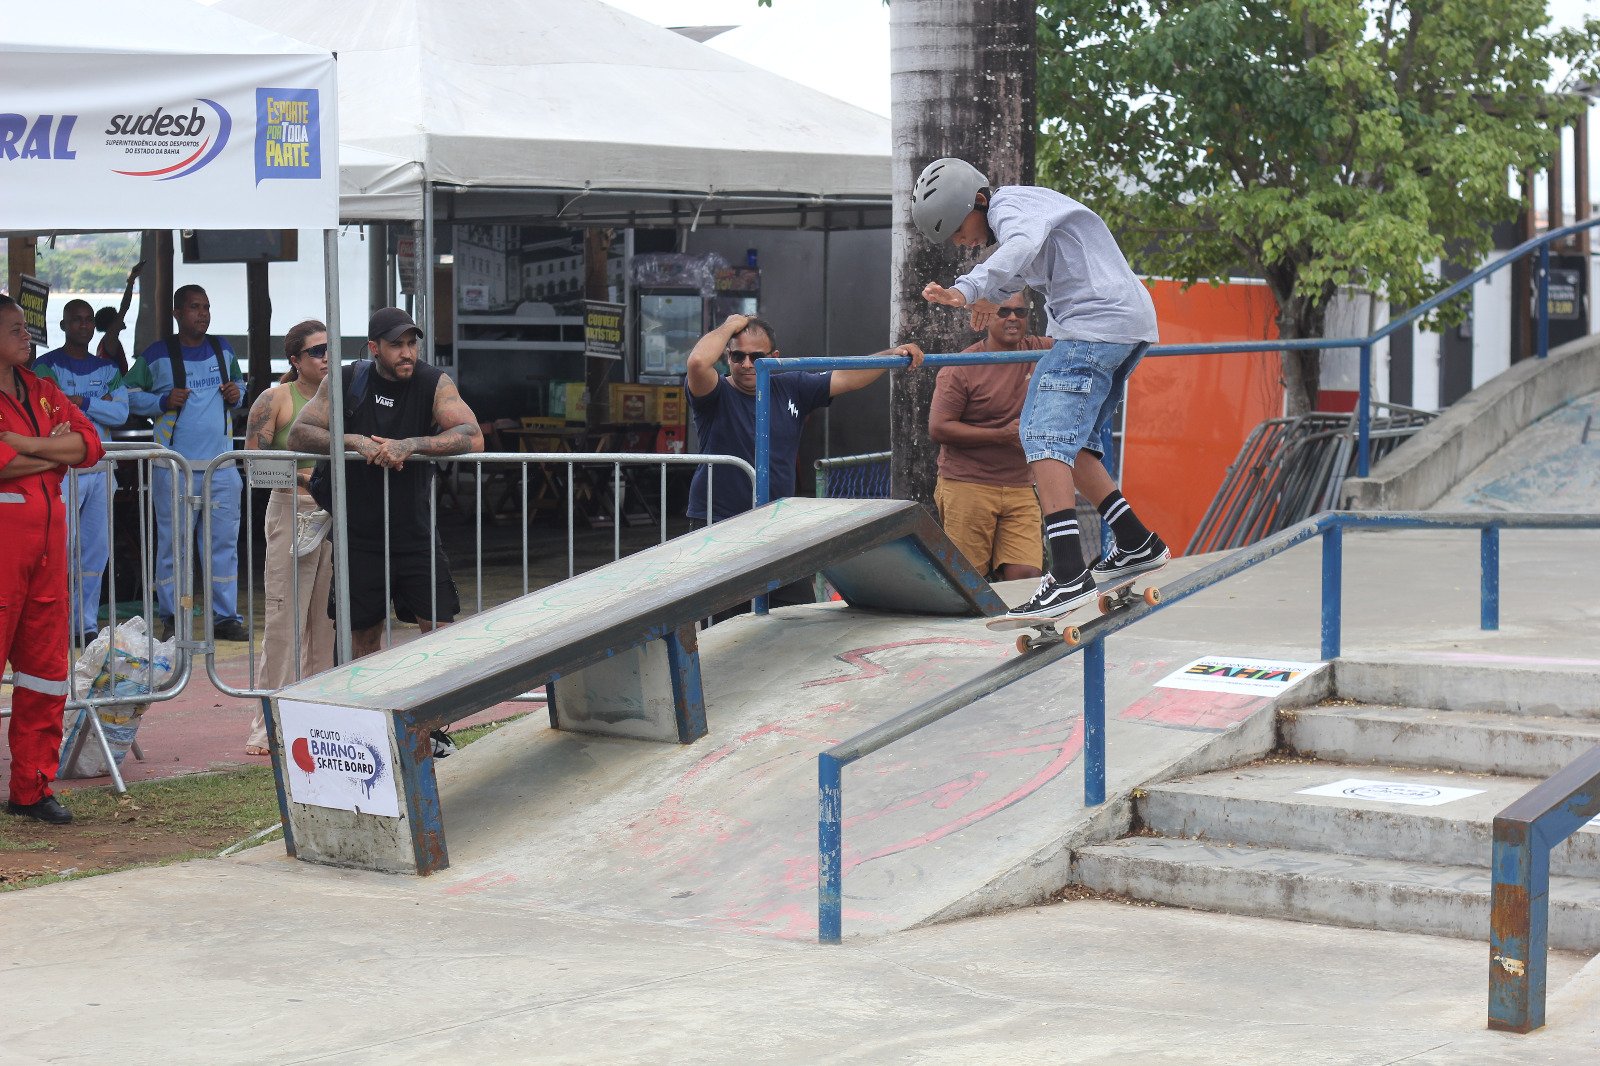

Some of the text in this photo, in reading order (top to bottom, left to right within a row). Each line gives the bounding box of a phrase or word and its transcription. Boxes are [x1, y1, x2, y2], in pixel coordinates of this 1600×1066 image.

[267, 97, 309, 124] ESPORTE
[105, 107, 205, 136] sudesb
[0, 113, 78, 161] RAL
[267, 122, 309, 142] POR TODA
[105, 139, 157, 147] SUPERINTENDÊNCIA
[266, 140, 310, 167] PARTE
[375, 394, 395, 407] VANS
[1184, 664, 1296, 682] BAHIA
[309, 728, 341, 741] CIRCUITO
[311, 739, 366, 760] BAIANO DE
[317, 757, 374, 775] SKATE BOARD
